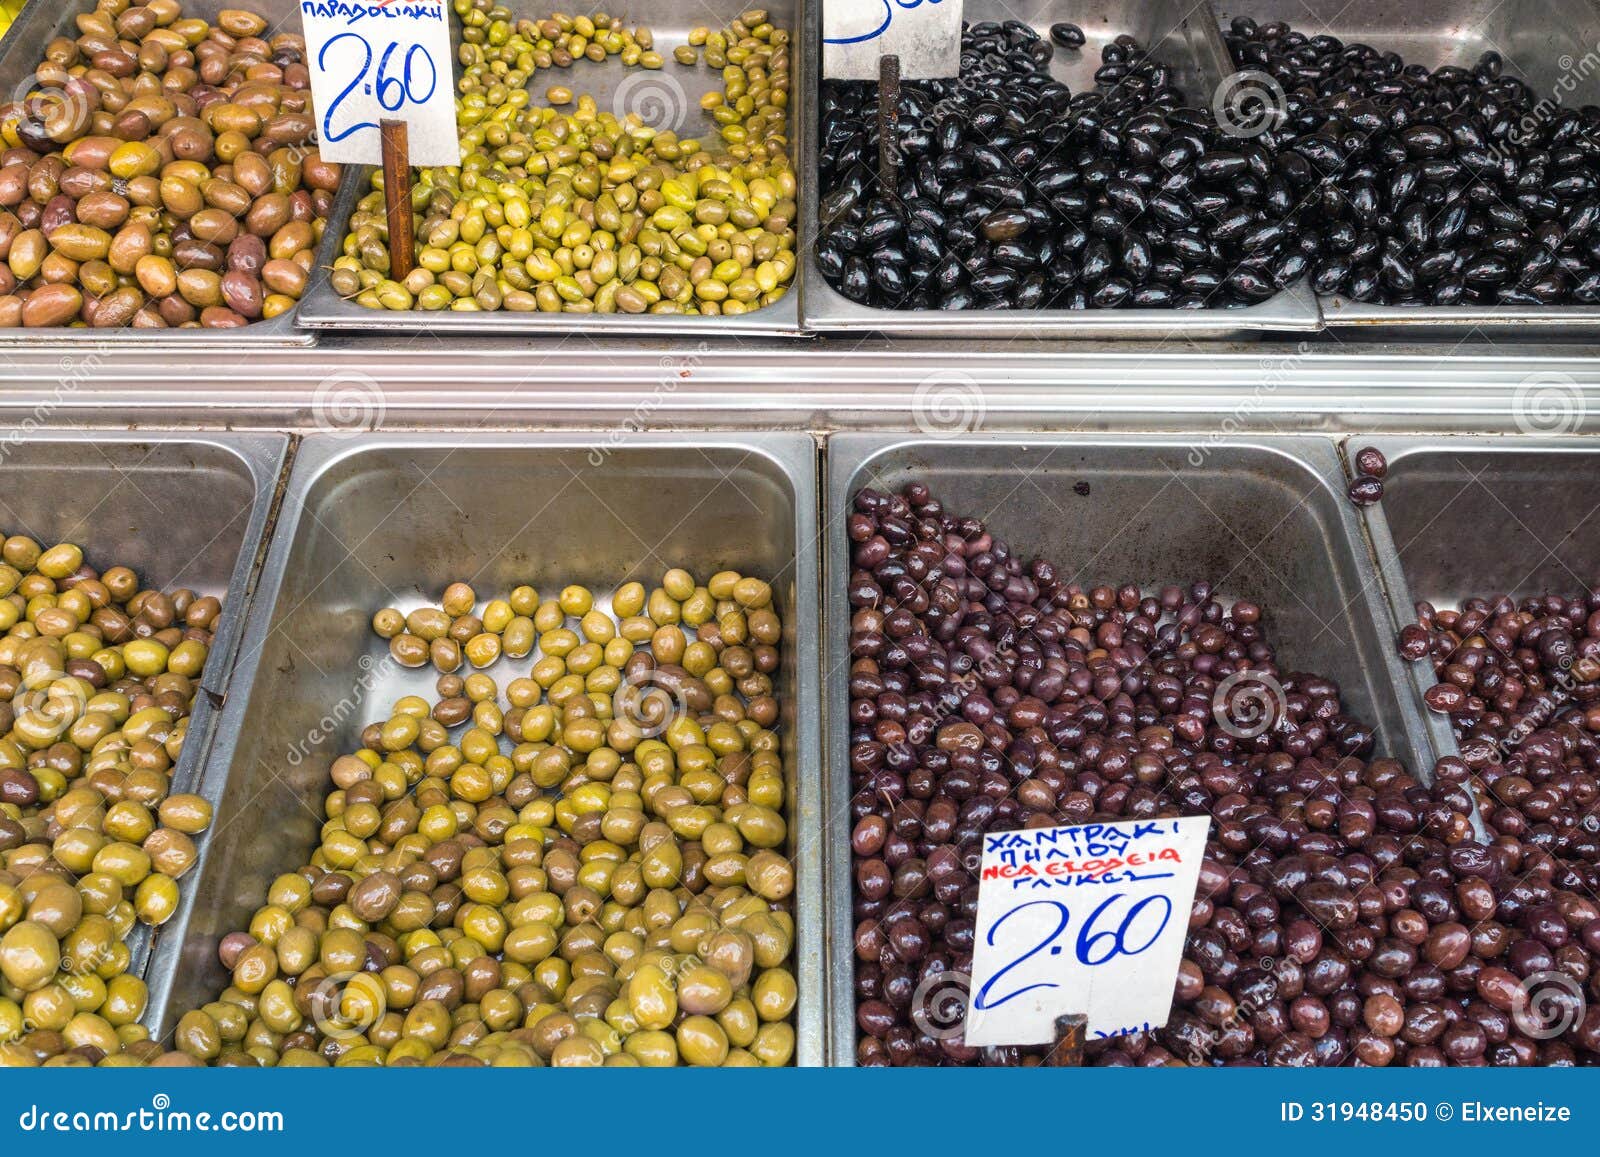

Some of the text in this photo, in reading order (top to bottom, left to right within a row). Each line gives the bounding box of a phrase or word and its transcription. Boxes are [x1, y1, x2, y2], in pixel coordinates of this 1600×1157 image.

[318, 33, 436, 142] 2.60
[986, 821, 1180, 853] ΧΑΝΤΡΑΚΙ
[1000, 841, 1129, 868] ΠΗΛΙΟΥ
[982, 864, 1038, 881] ΝΕΑ
[974, 893, 1172, 1010] 2.60
